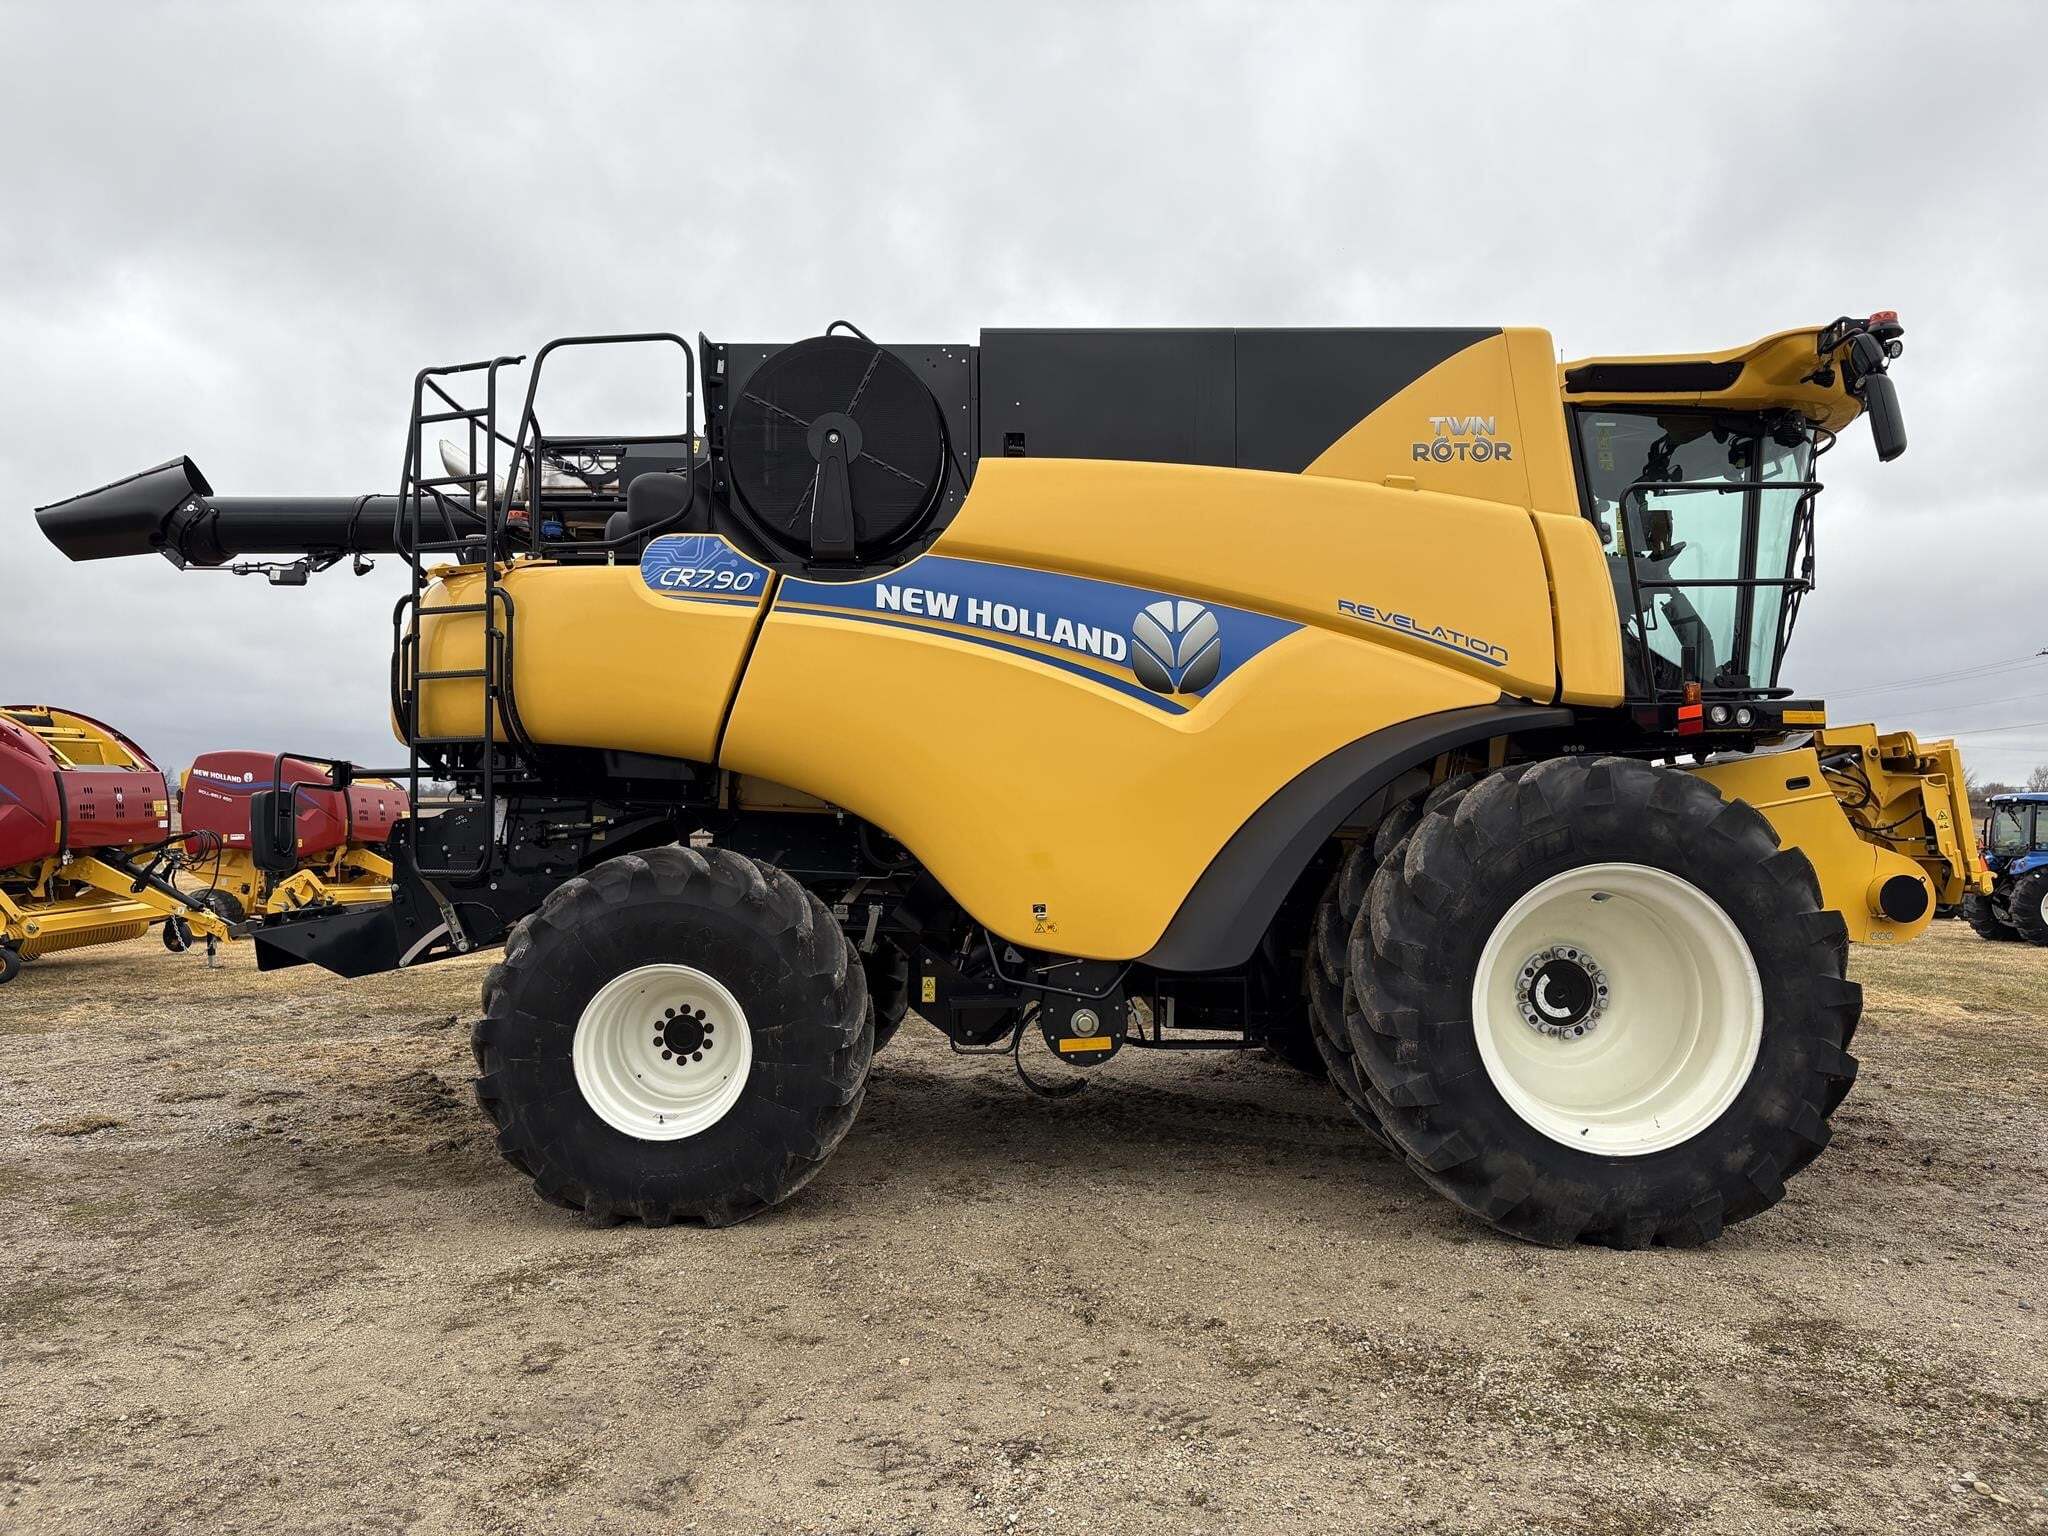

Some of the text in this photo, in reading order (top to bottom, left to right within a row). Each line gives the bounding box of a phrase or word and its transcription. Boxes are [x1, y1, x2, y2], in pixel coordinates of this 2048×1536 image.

[1428, 415, 1496, 436] TWIN
[1412, 435, 1513, 463] ROTOR
[660, 567, 755, 591] CR7.90
[876, 583, 1127, 662] NEW HOLLAND
[1337, 599, 1509, 662] REVELATION
[193, 768, 242, 783] NEW HOLLAND
